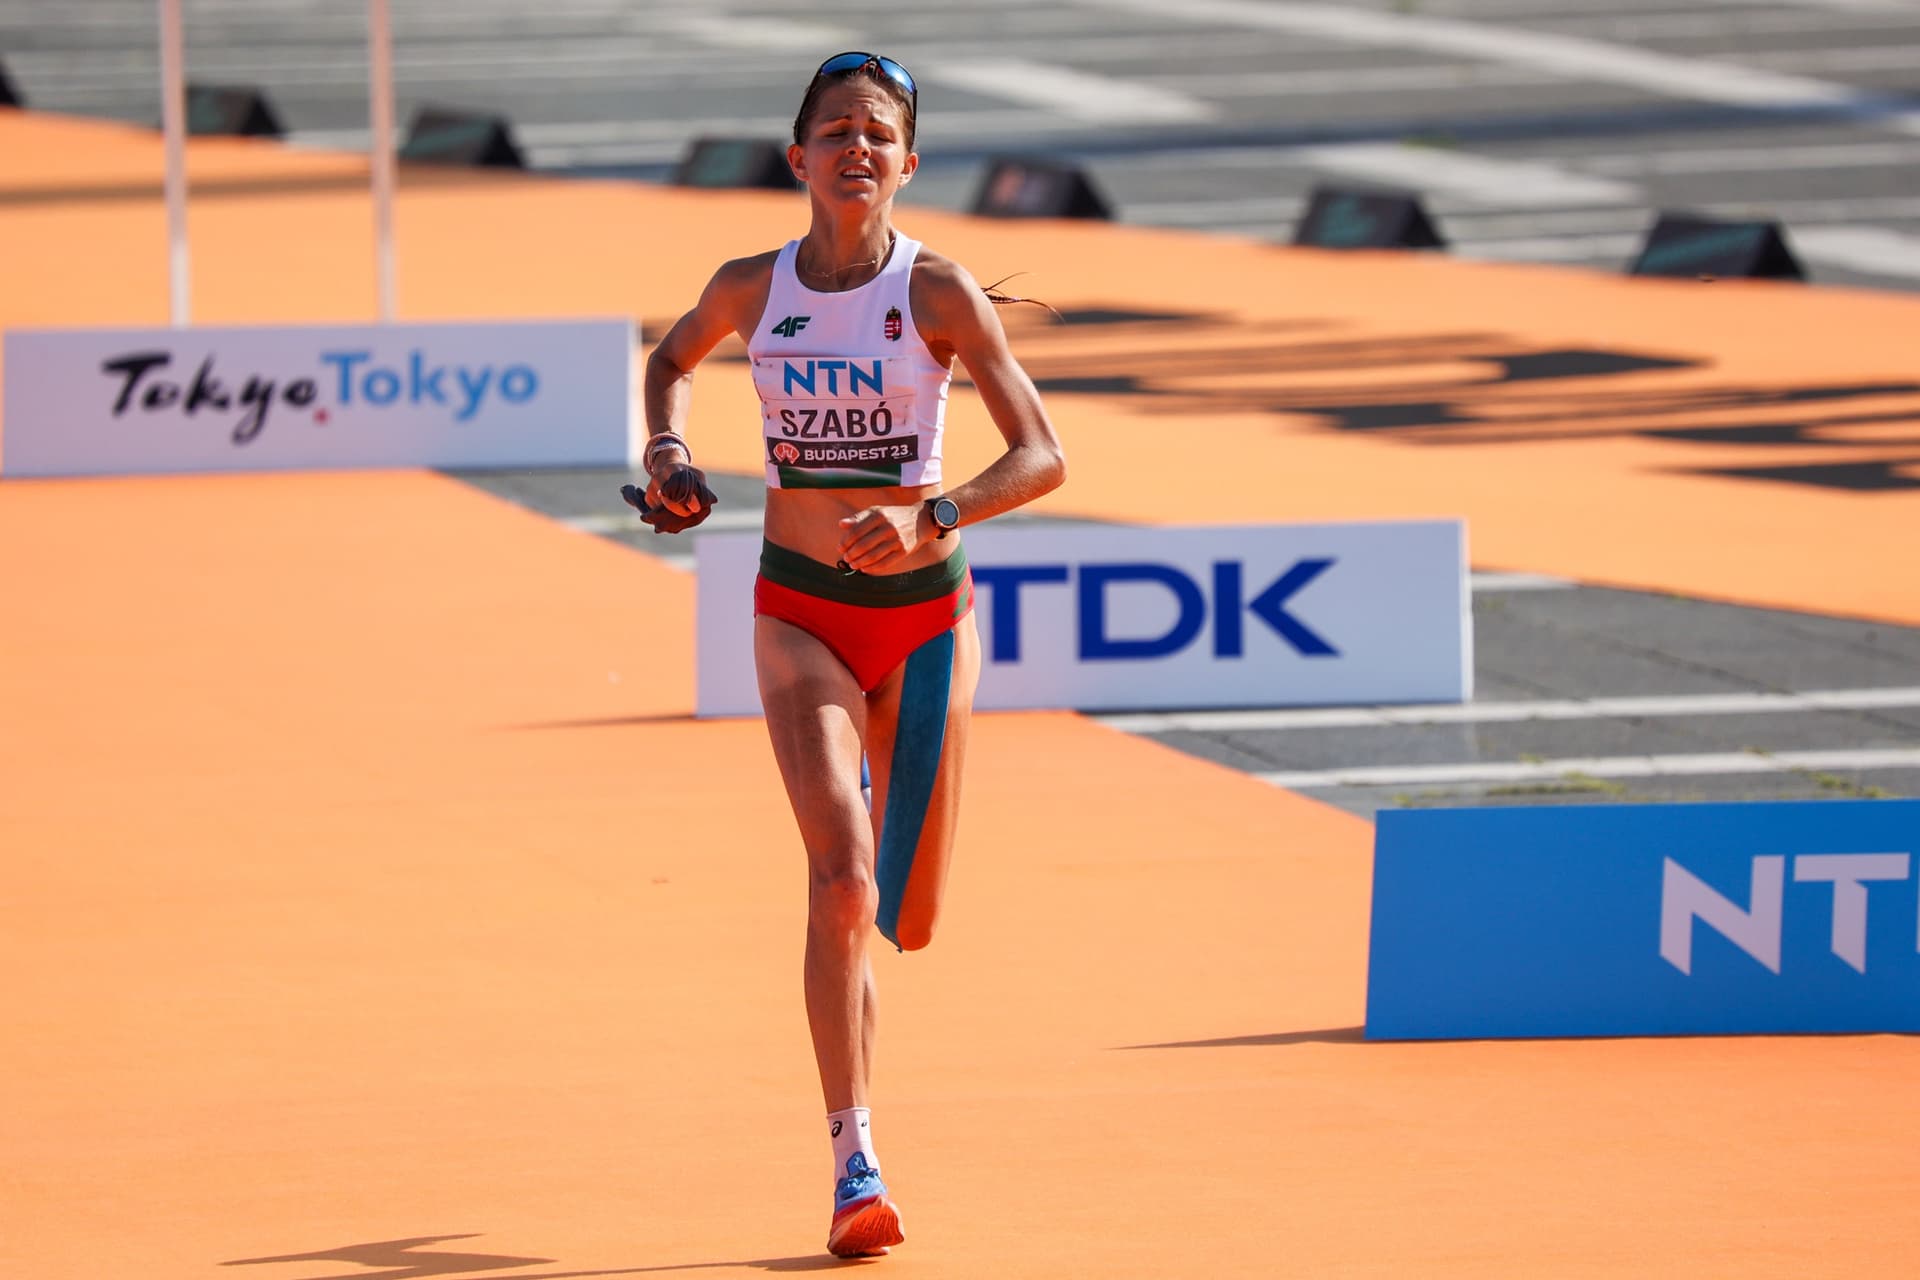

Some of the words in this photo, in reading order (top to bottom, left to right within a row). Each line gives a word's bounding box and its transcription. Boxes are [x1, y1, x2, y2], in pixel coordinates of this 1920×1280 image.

[771, 316, 811, 338] 4F
[783, 360, 883, 397] NTN
[102, 351, 319, 447] Tokyo
[320, 351, 540, 422] Tokyo
[780, 401, 893, 438] SZABÓ
[804, 447, 889, 461] BUDAPEST
[890, 444, 909, 458] 23
[971, 557, 1344, 663] TDK
[1659, 852, 1920, 976] NT
